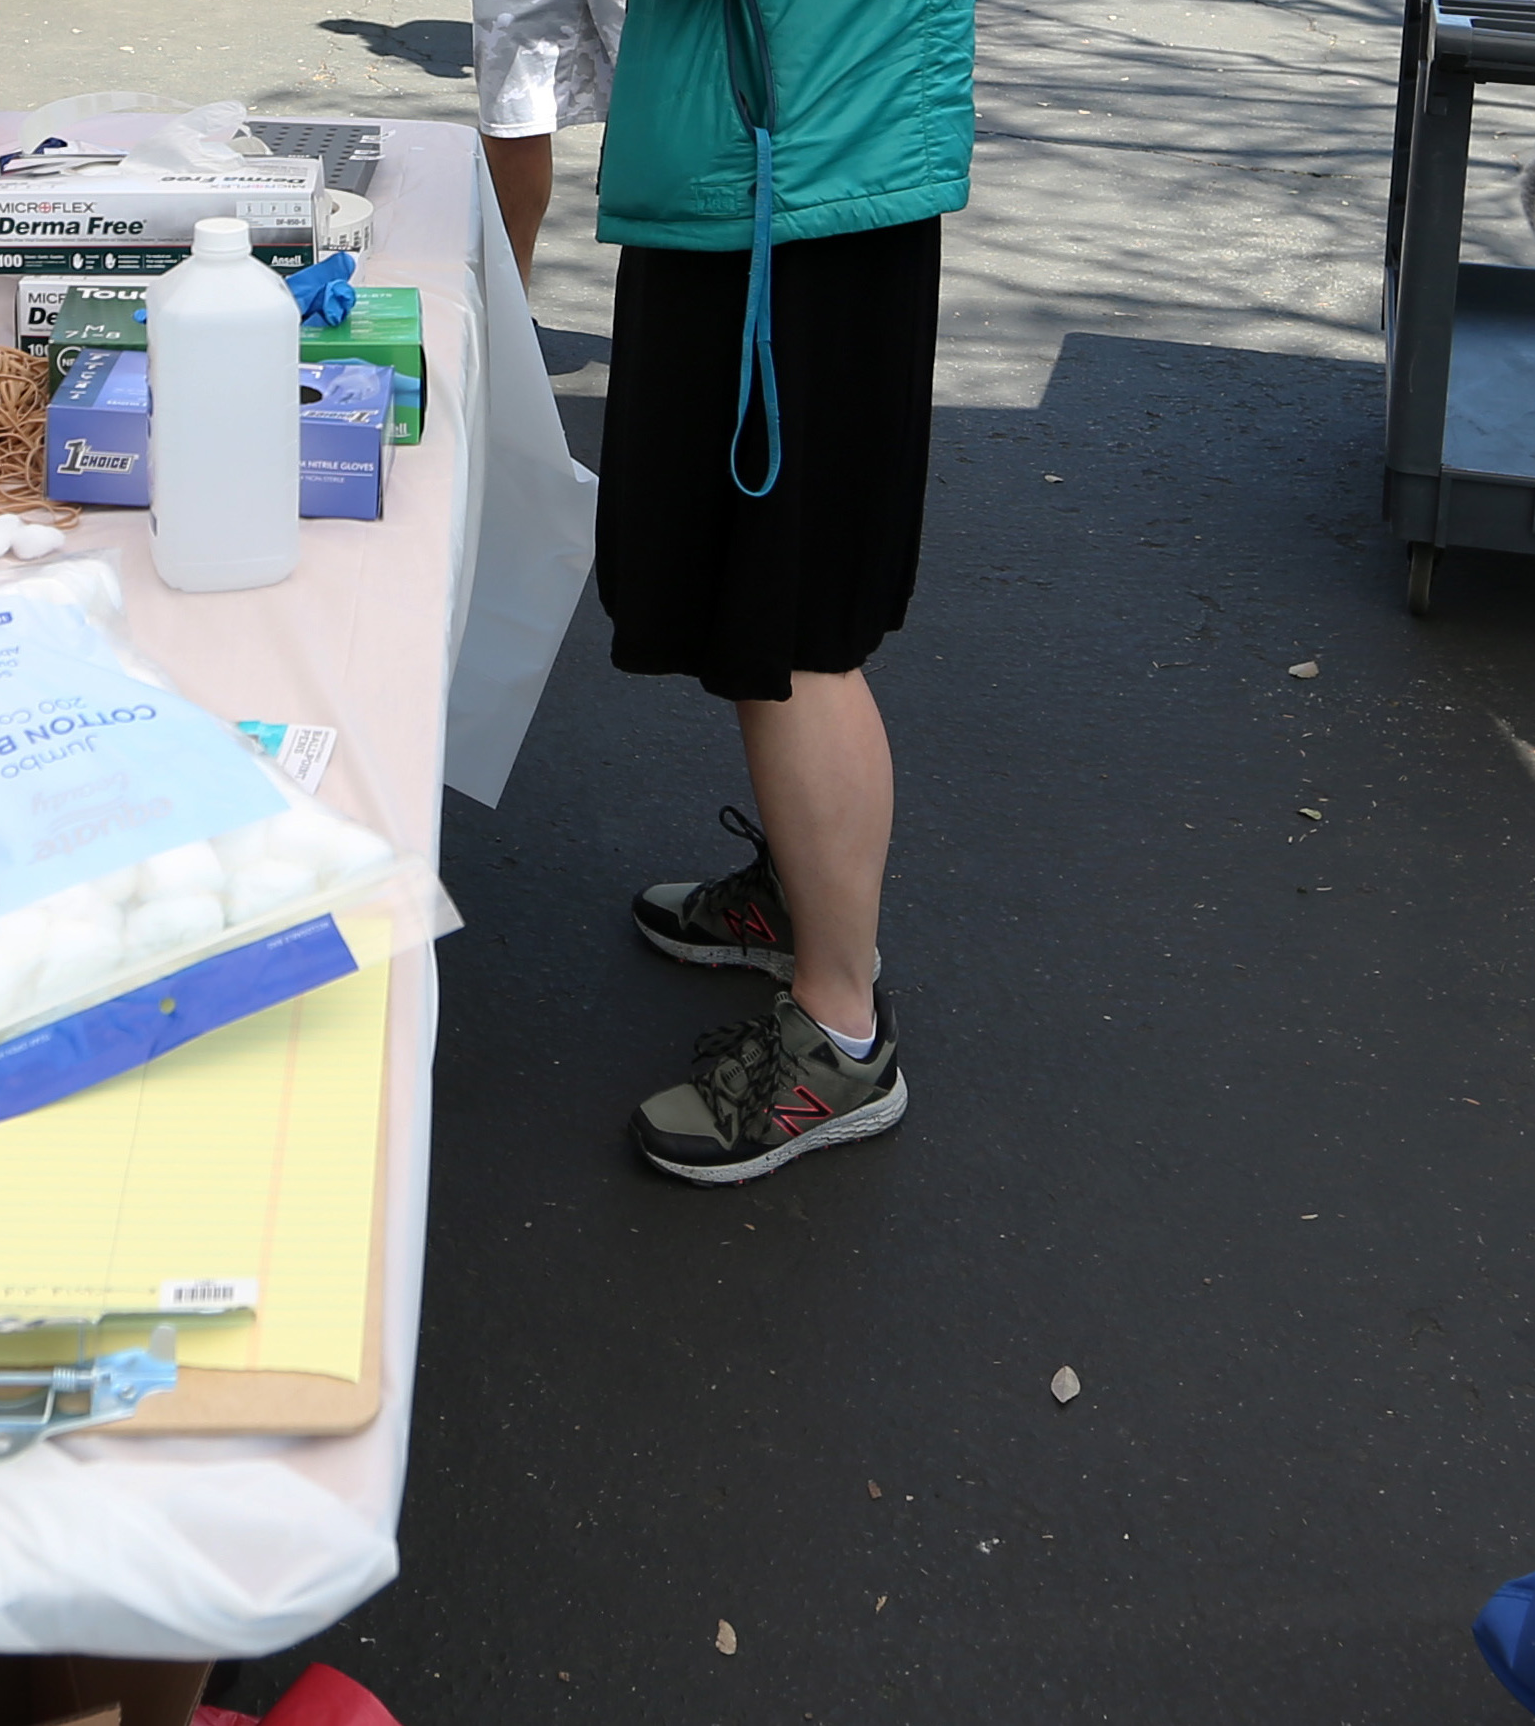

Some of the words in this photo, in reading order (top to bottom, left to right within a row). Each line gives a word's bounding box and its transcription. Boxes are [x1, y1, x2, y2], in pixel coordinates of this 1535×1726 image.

[87, 217, 147, 236] Free
[271, 255, 303, 265] Ansell
[79, 455, 130, 470] CHOICE
[308, 461, 338, 470] NITRILE
[340, 462, 374, 472] GLOVES
[38, 696, 88, 715] 200
[26, 704, 158, 746] COTTON
[0, 734, 100, 780] Jumbo
